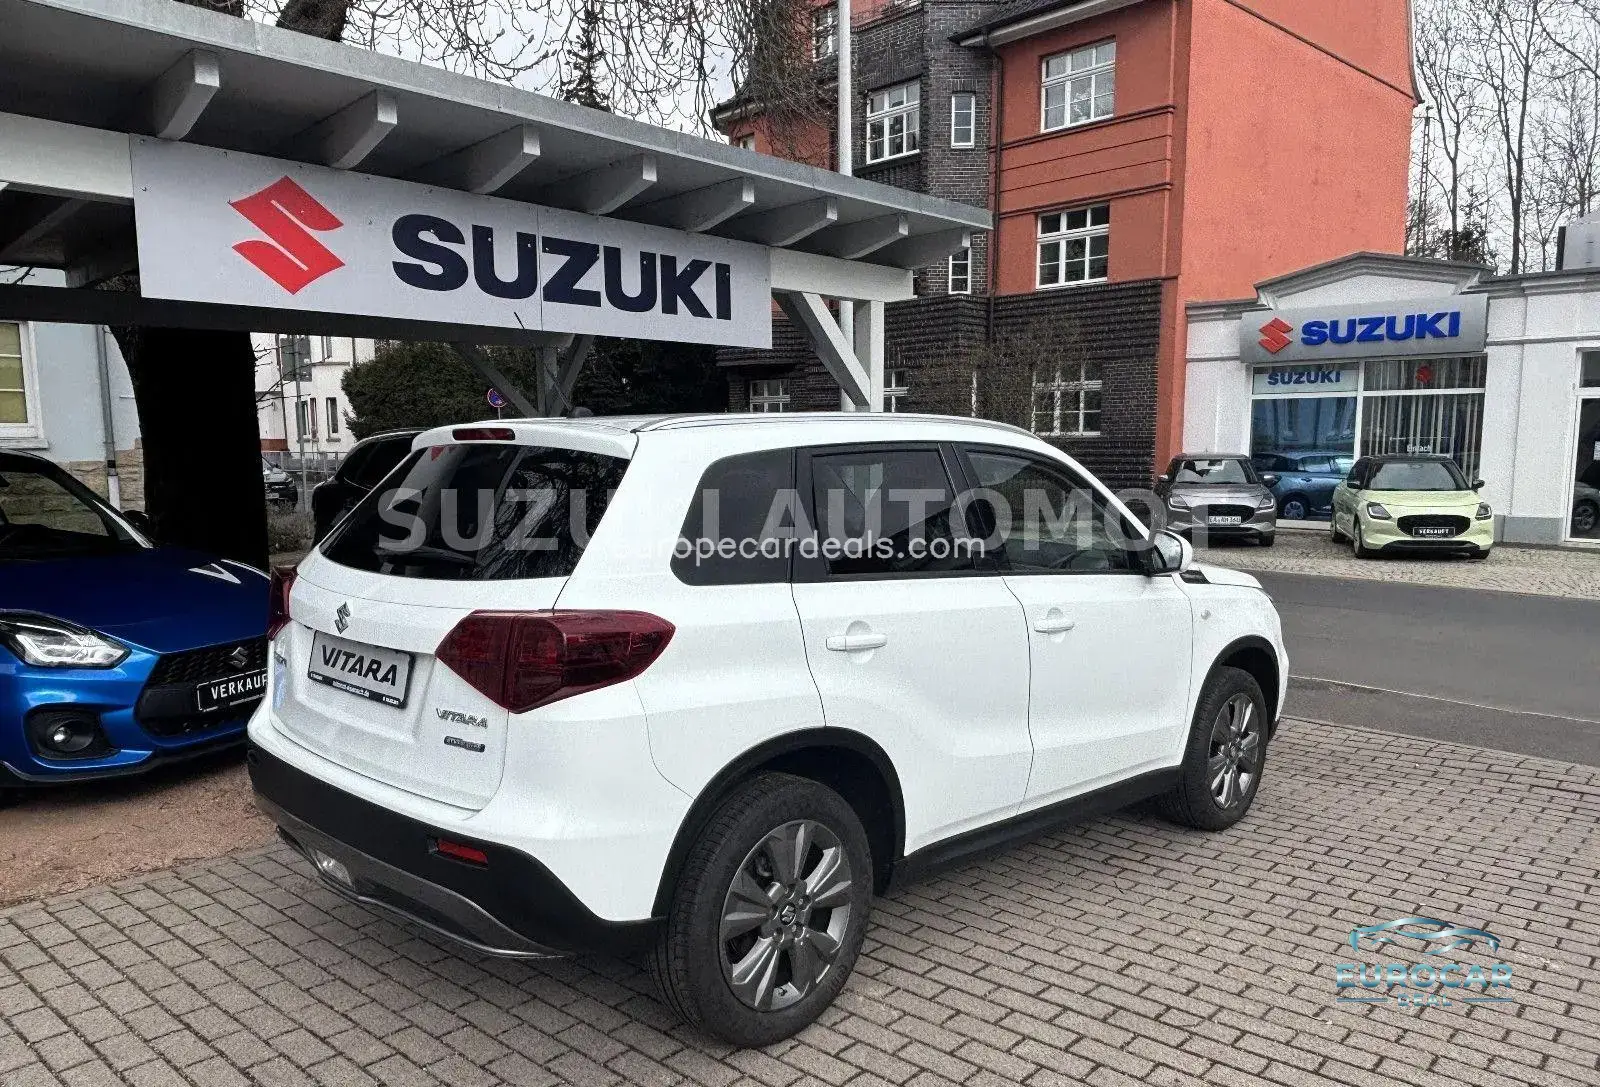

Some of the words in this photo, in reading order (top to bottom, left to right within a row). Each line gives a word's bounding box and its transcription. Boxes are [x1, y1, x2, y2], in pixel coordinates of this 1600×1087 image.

[391, 213, 732, 321] SUZUKI
[1300, 311, 1461, 346] SUZUKI
[1267, 370, 1341, 386] SUZUKI
[321, 643, 398, 687] VITARA
